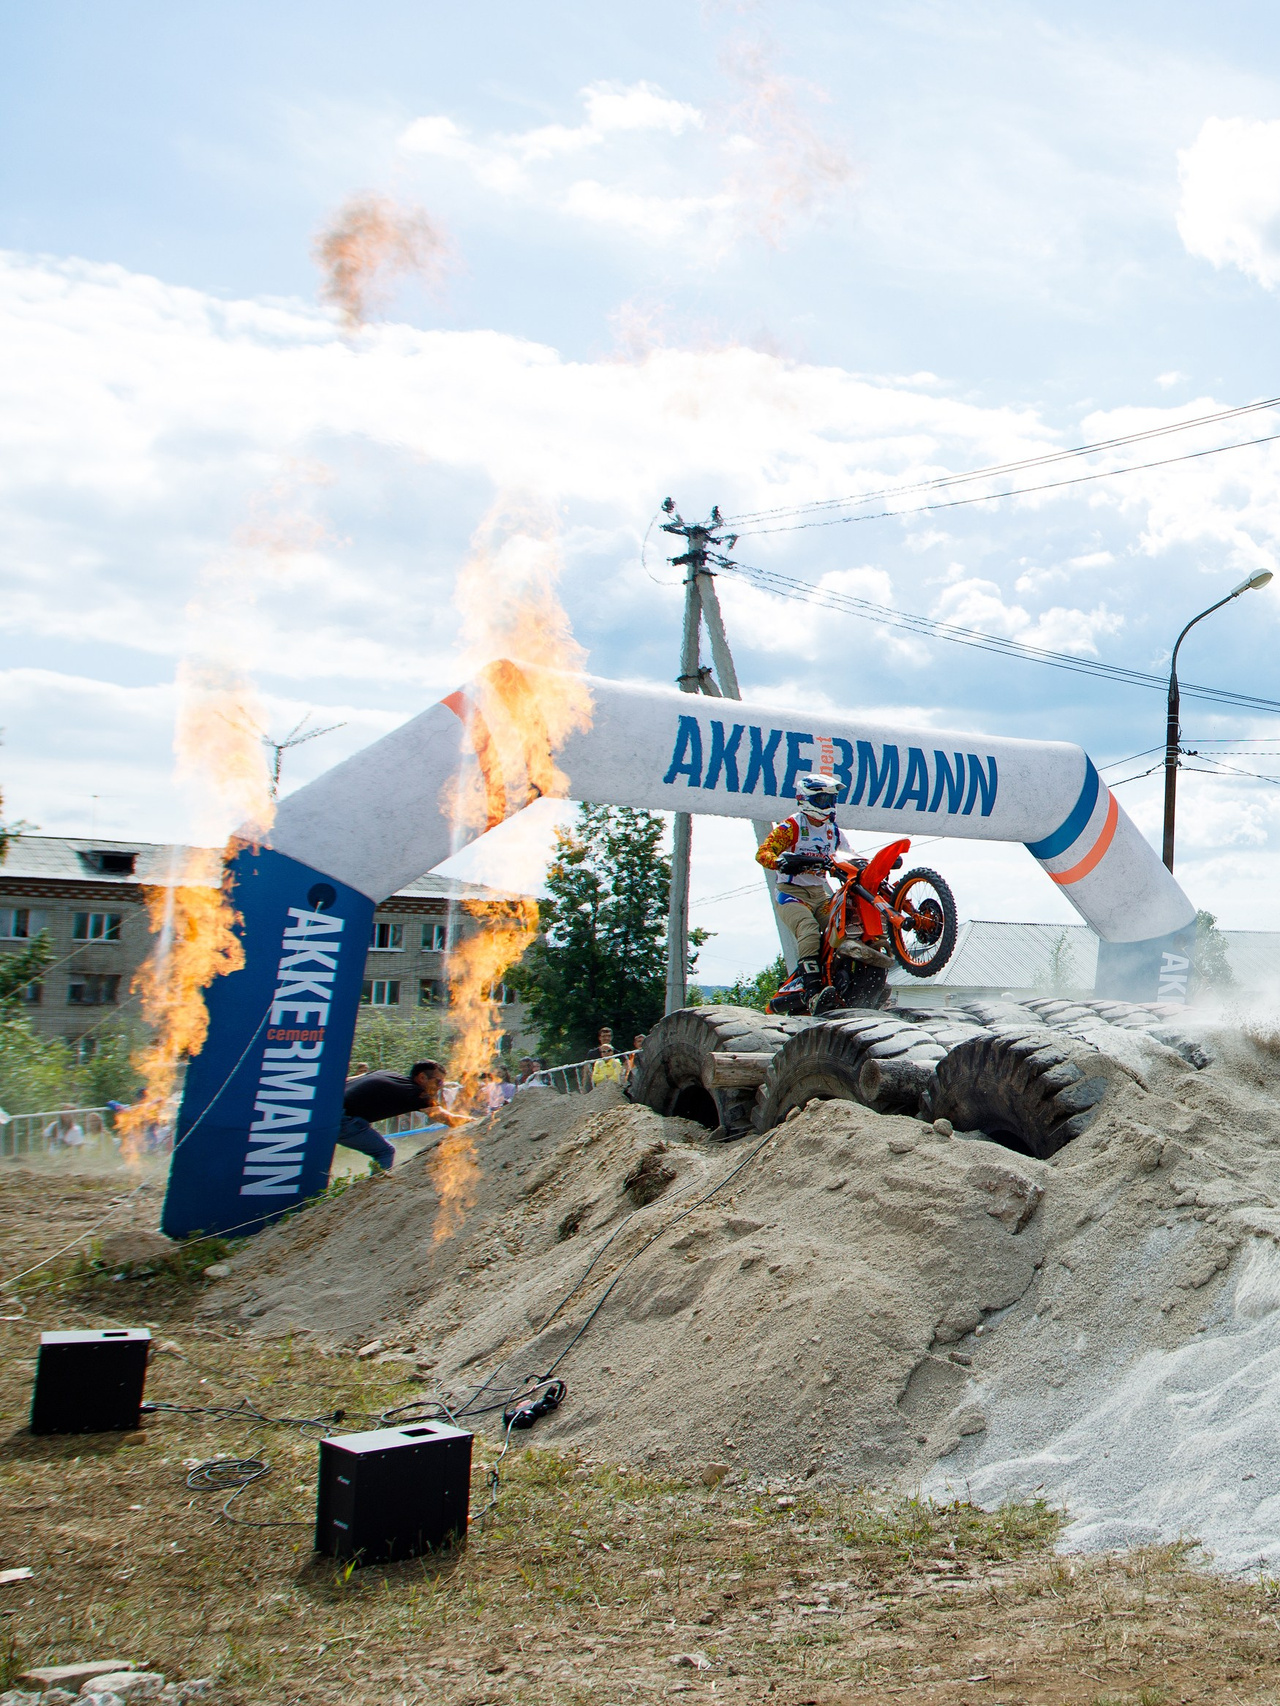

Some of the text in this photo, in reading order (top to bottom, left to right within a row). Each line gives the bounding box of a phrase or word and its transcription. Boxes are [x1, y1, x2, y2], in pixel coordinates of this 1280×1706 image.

[663, 715, 998, 817] AKKERMANN
[239, 907, 346, 1196] AKKERMANN
[267, 1026, 325, 1042] cement
